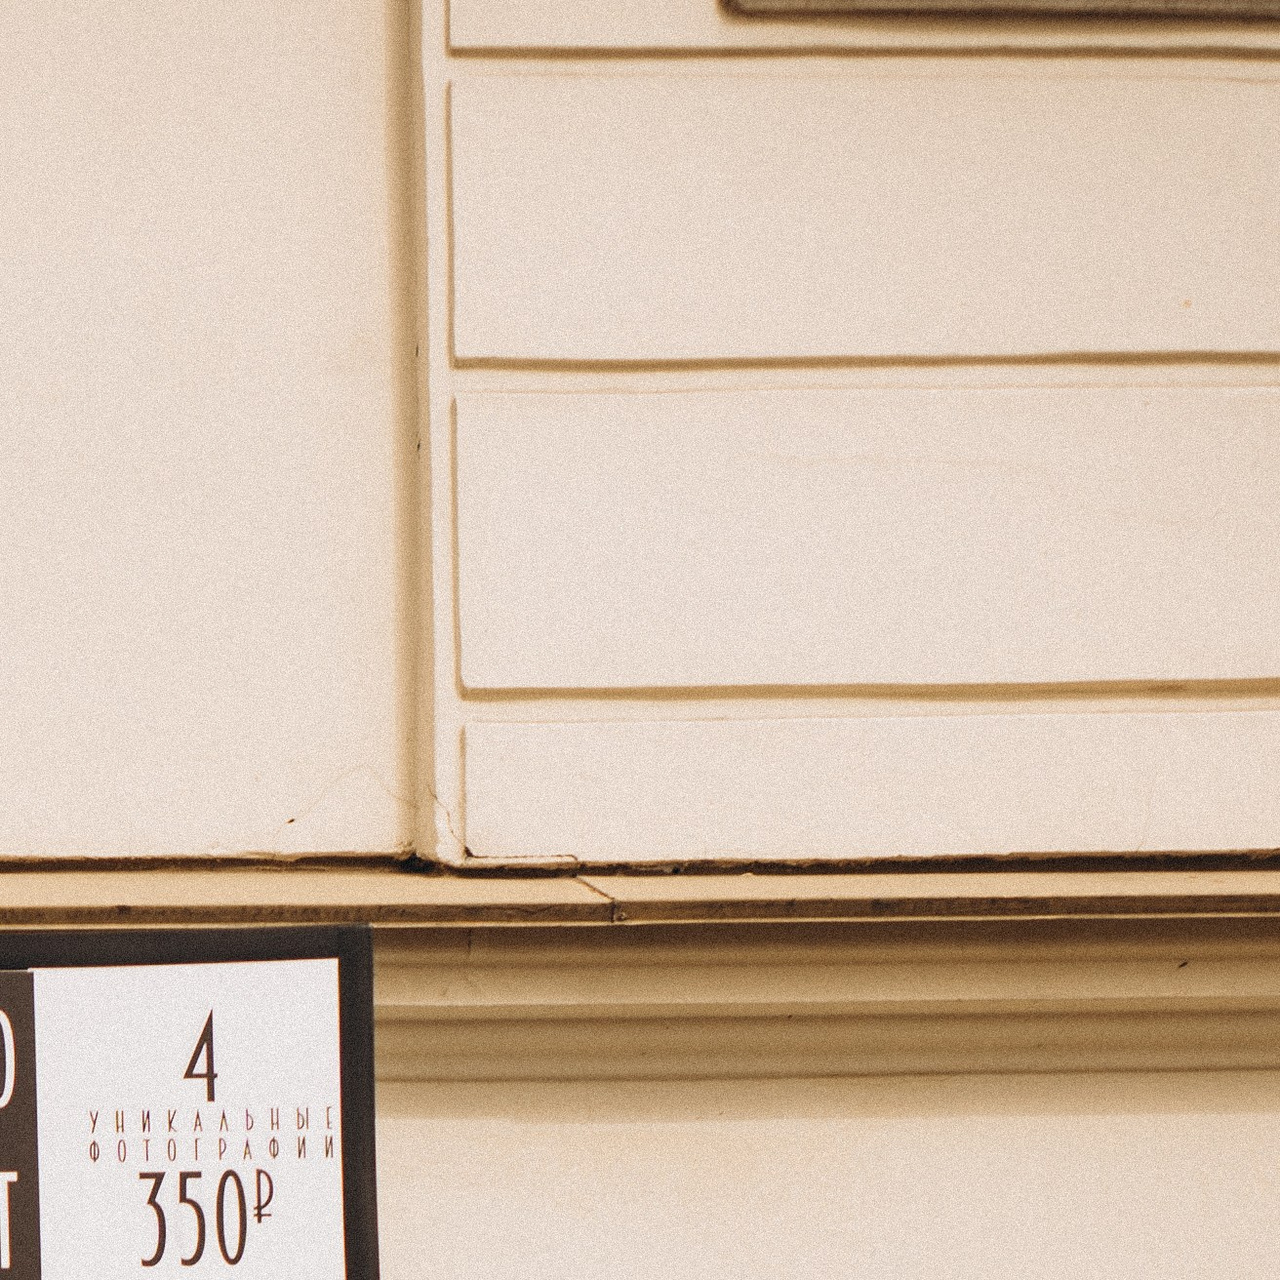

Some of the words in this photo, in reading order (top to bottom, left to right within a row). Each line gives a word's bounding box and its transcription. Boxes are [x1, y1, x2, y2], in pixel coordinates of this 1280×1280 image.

[183, 1008, 218, 1102] 4
[89, 1106, 333, 1134] УНИКАЛЬНЫЕ
[89, 1136, 334, 1163] ФОТОГРАФИИ
